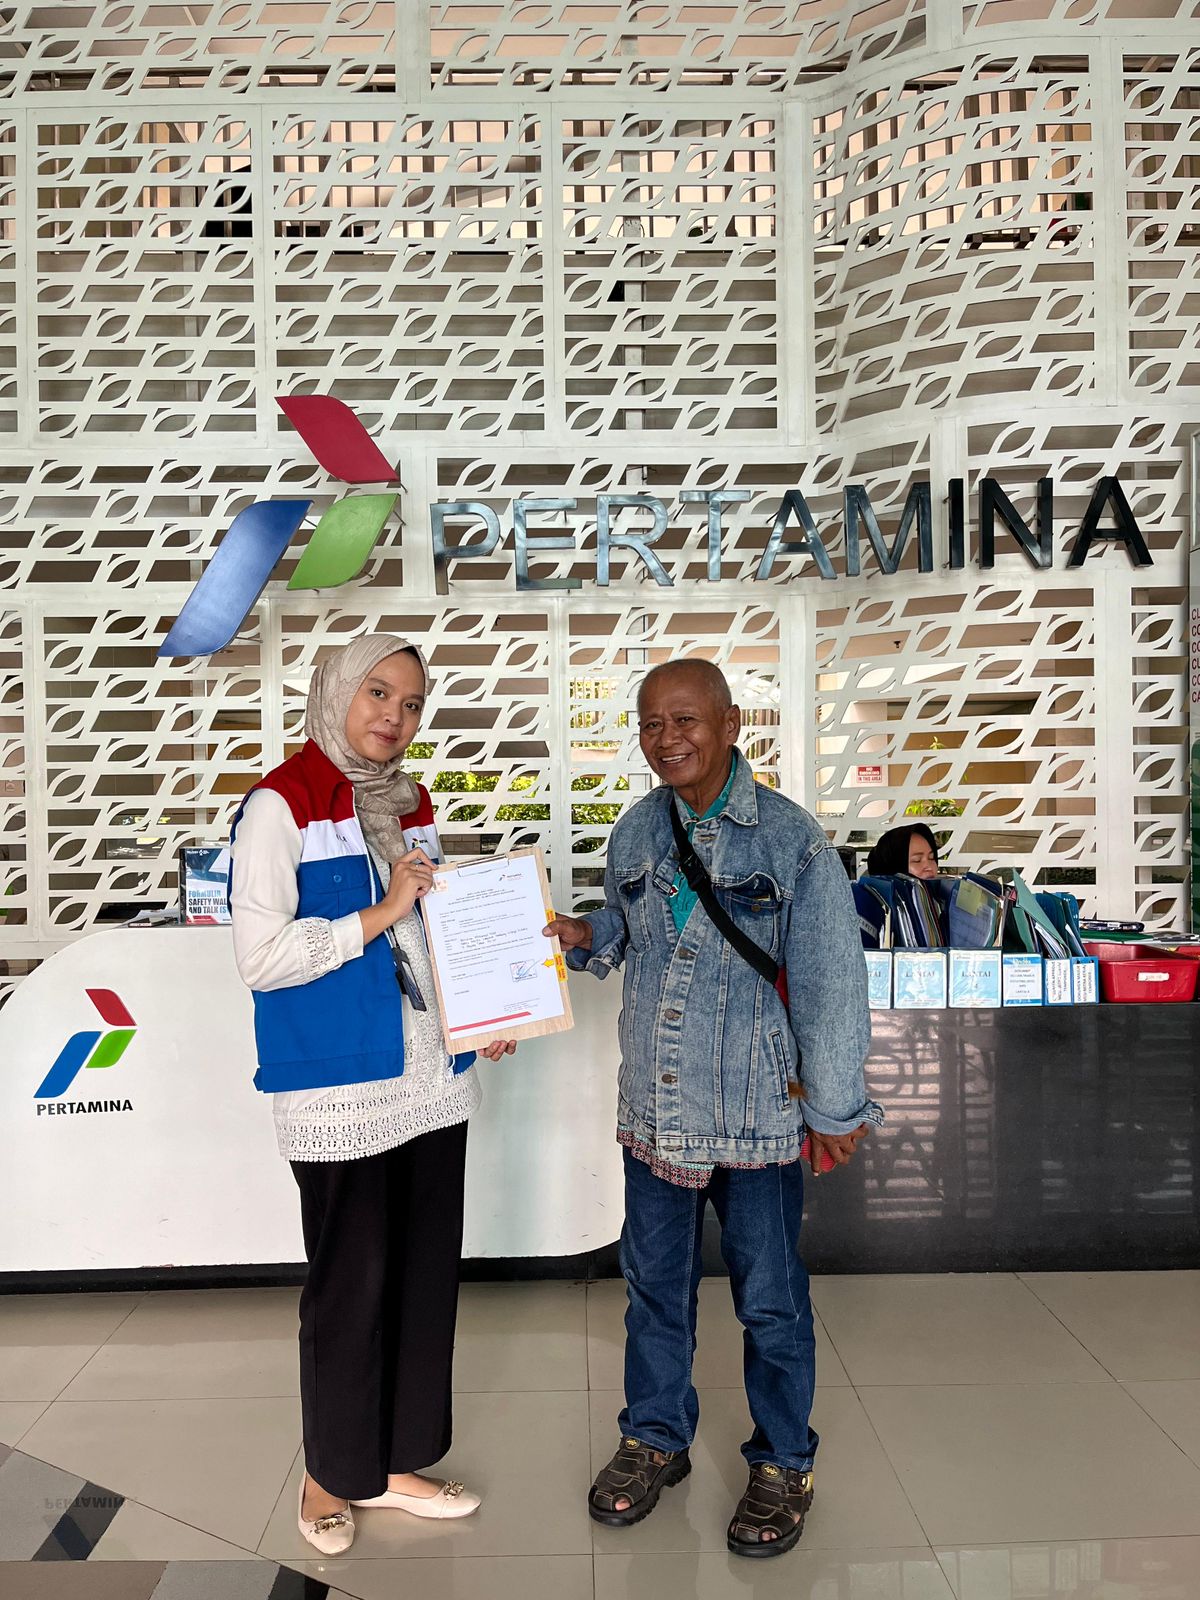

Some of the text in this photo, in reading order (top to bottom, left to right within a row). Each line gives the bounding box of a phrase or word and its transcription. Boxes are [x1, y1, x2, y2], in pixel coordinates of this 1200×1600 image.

[430, 475, 1154, 596] PERTAMINA
[188, 898, 227, 906] SAFETY WAL
[188, 906, 202, 914] AND
[203, 906, 219, 914] TALK
[37, 1099, 133, 1116] PERTAMINA
